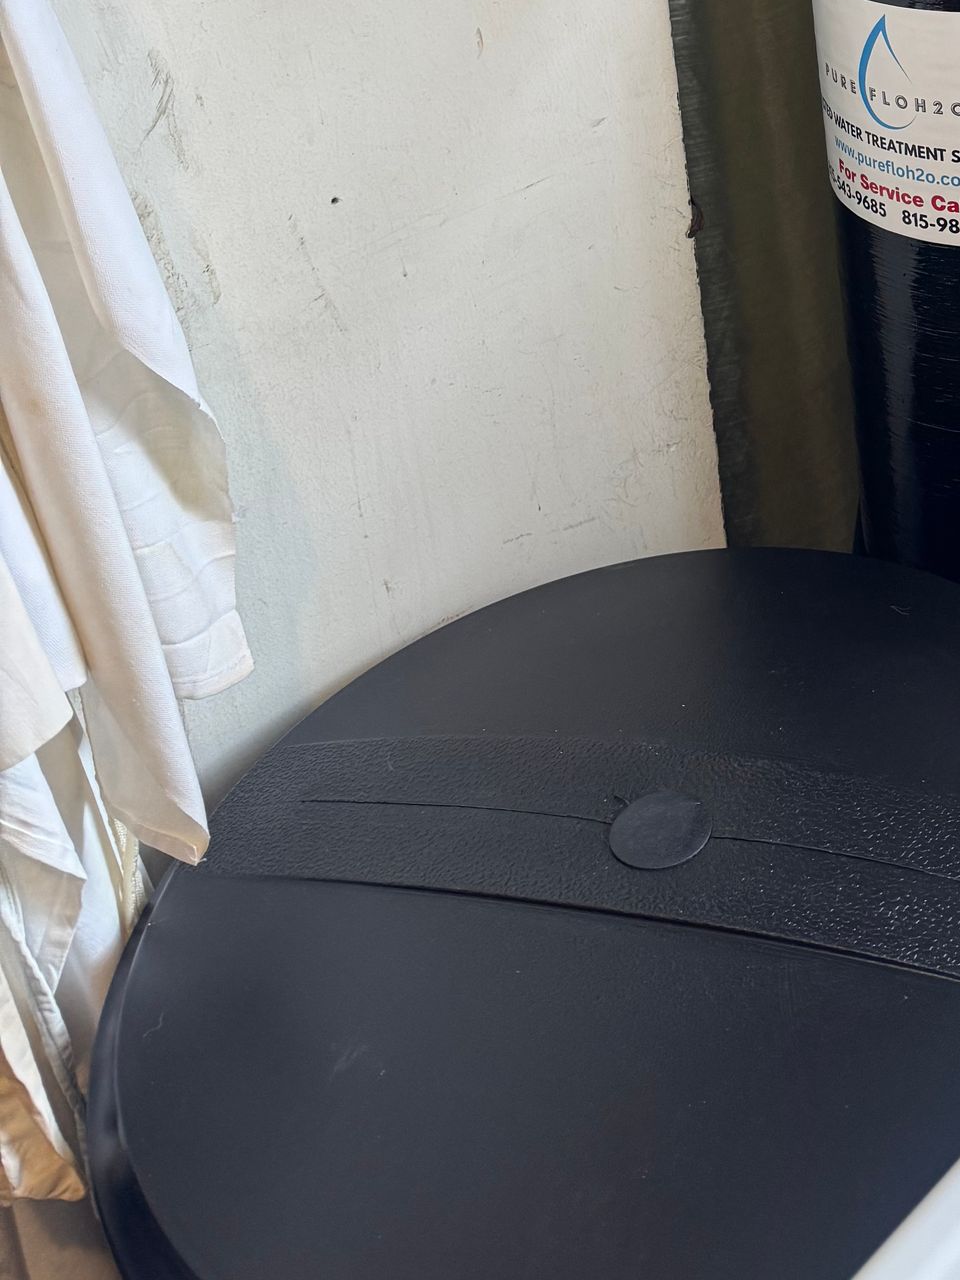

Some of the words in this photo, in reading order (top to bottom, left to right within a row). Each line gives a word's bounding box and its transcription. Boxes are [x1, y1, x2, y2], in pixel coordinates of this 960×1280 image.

[825, 62, 856, 94] PURE
[833, 111, 863, 142] WATER
[865, 131, 946, 162] TREATMENT
[838, 158, 856, 182] For
[860, 174, 924, 208] Service
